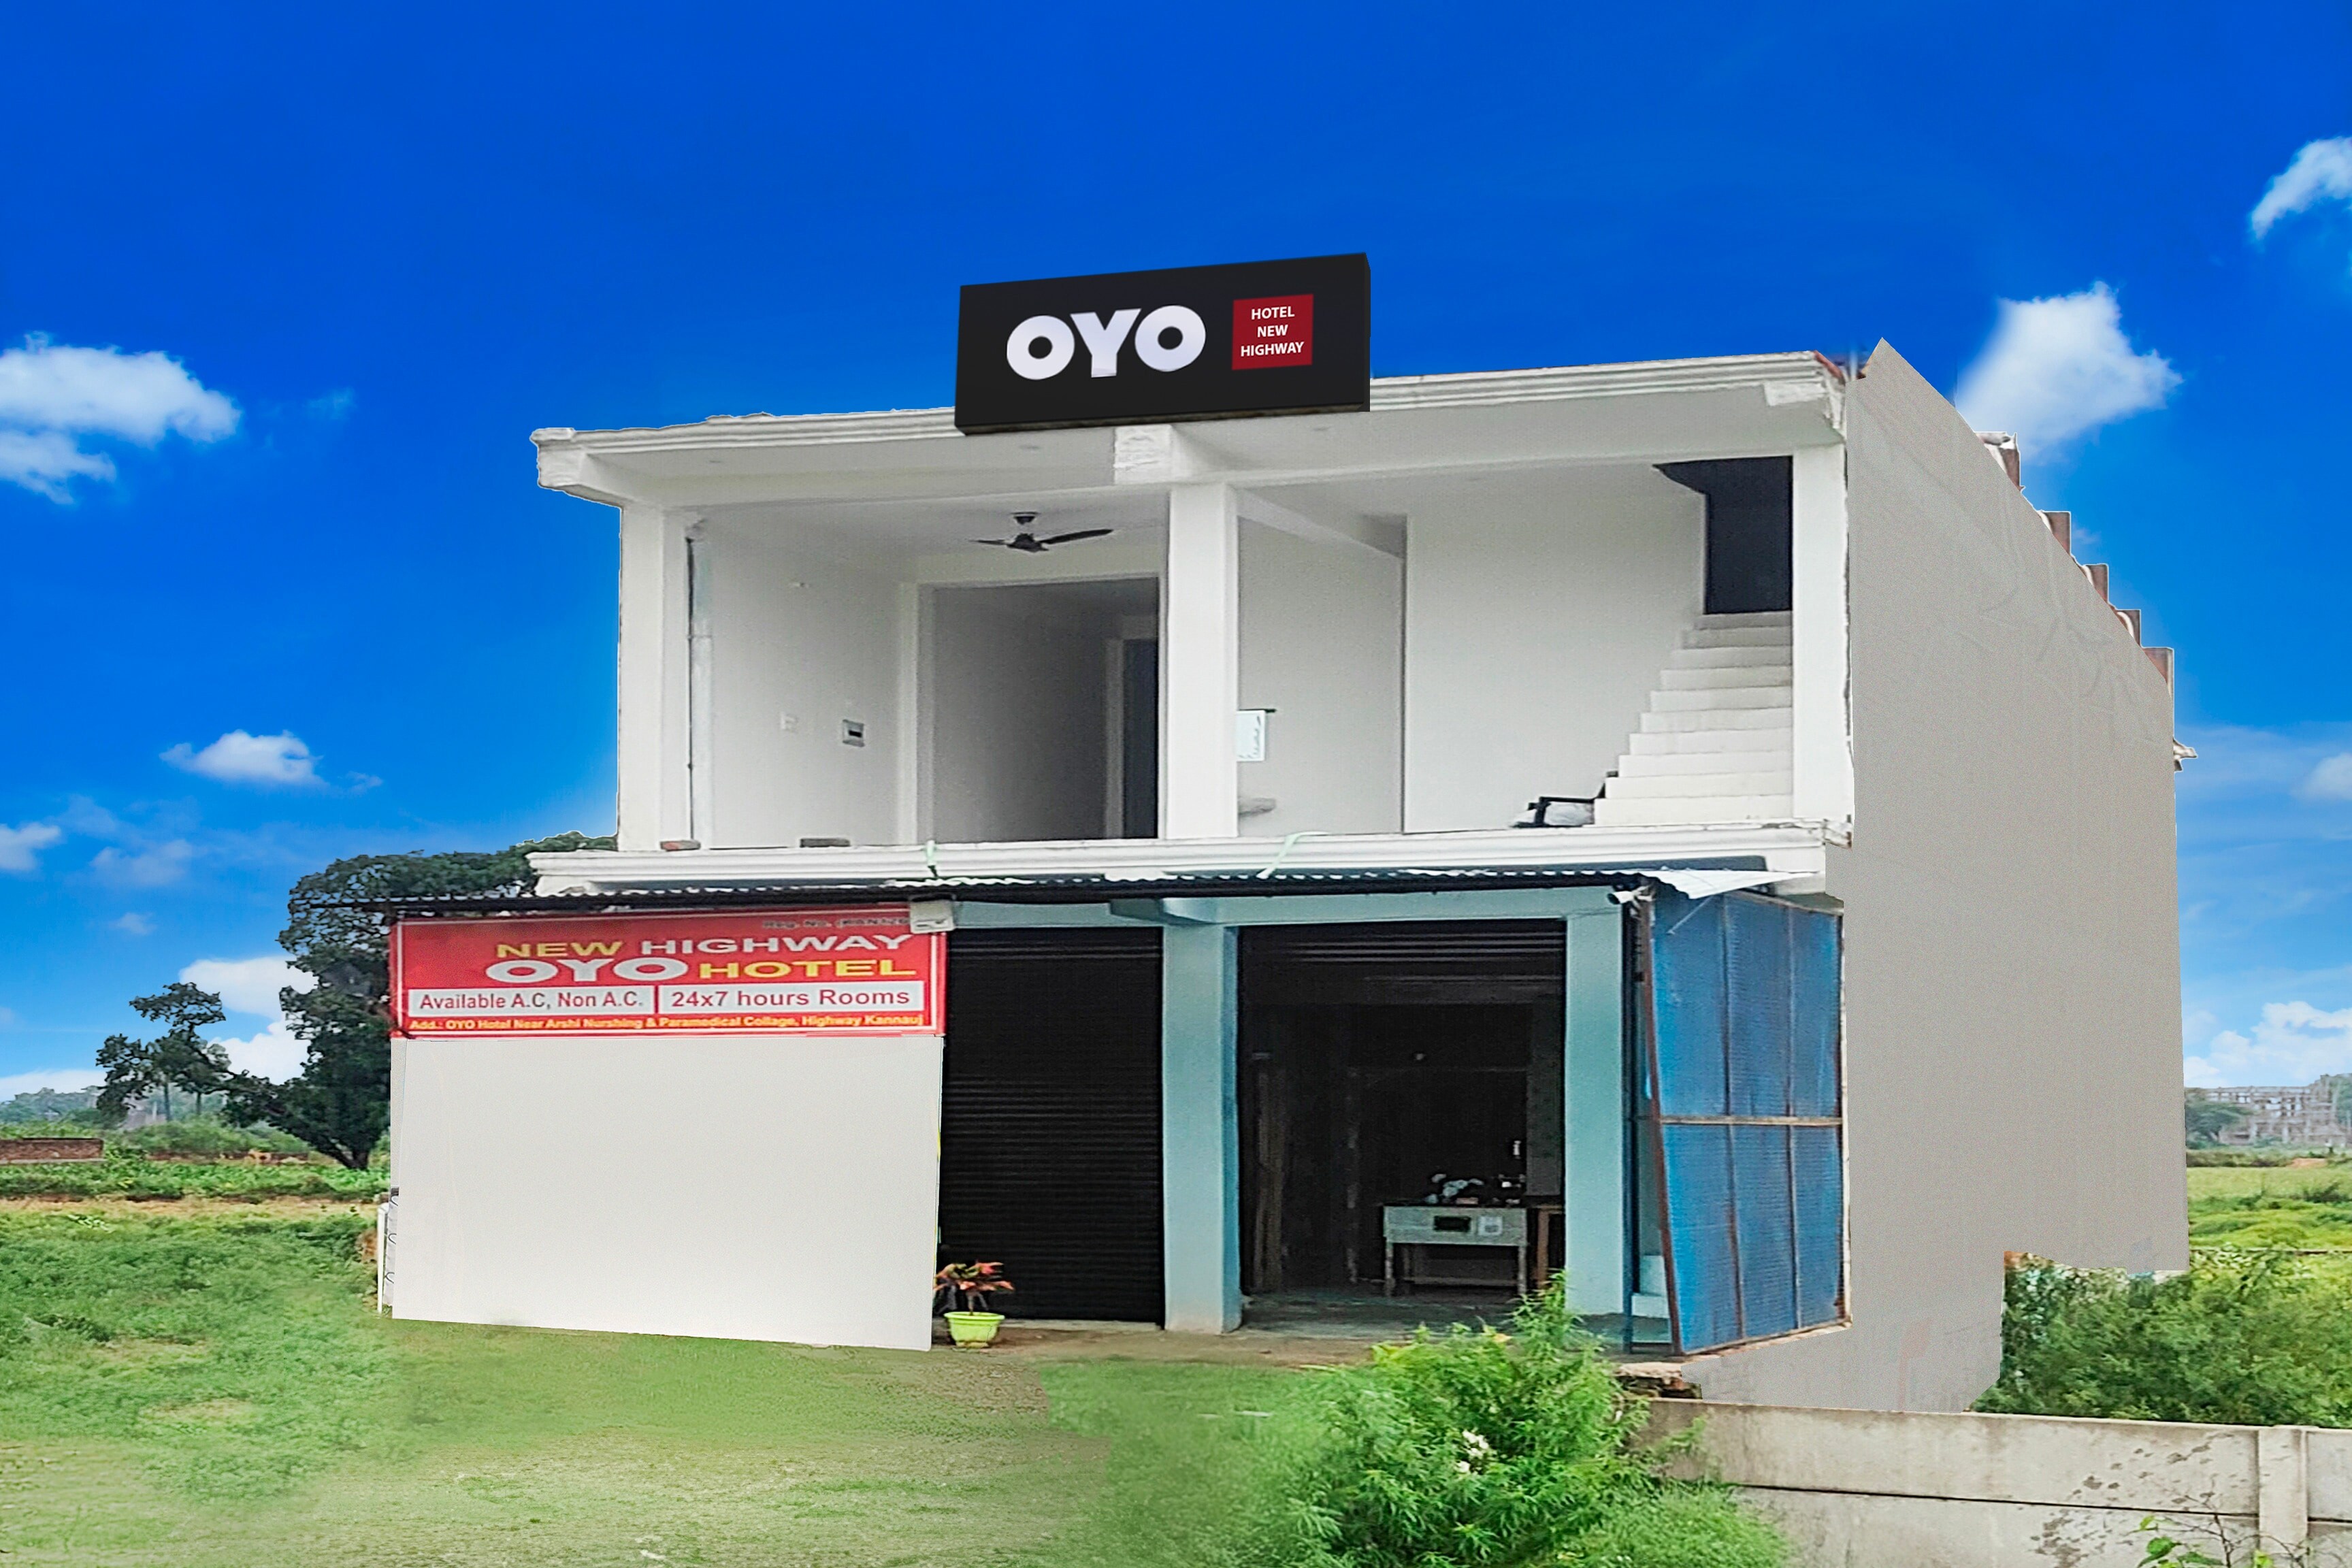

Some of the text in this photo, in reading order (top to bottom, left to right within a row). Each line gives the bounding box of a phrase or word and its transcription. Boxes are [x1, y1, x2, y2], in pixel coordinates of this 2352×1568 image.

[1251, 306, 1295, 320] HOTEL
[1257, 324, 1288, 338] NEW
[1007, 305, 1207, 380] OYO
[1241, 341, 1305, 357] HIGHWAY
[496, 934, 913, 958] NEW HIGHWAY
[485, 957, 917, 983] OYO HOTEL
[419, 994, 506, 1009] Available
[557, 992, 597, 1007] Non
[602, 990, 644, 1007] A.C.
[672, 989, 911, 1007] 24x7 hours Rooms
[446, 1019, 476, 1030] OYO
[478, 1019, 511, 1029] Hotel
[514, 1019, 544, 1028] Near
[646, 1017, 657, 1027] &
[658, 1017, 741, 1028] Paramedical
[802, 1015, 862, 1027] Highway
[864, 1014, 924, 1026] Kannauj
